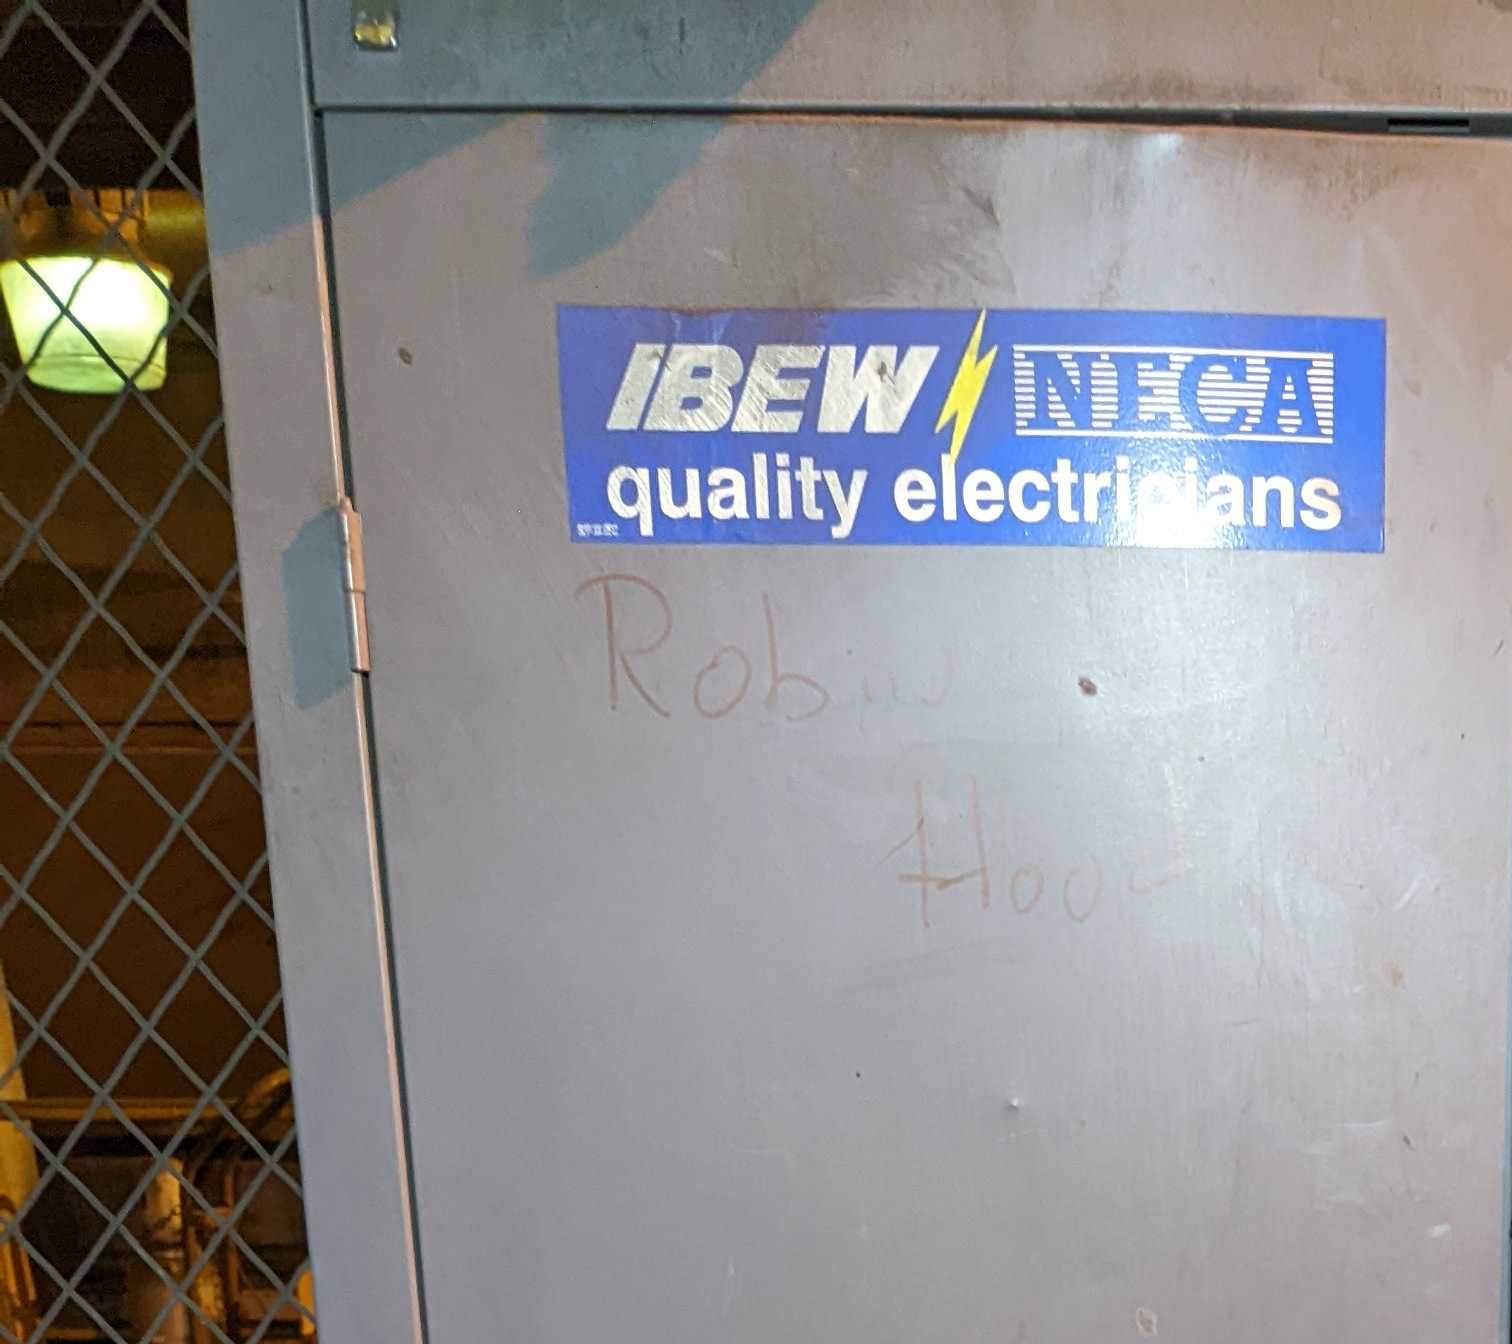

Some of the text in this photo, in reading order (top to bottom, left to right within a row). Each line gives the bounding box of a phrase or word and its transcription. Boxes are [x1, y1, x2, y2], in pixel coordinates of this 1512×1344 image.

[606, 344, 1335, 443] IBEW NECA
[606, 454, 1342, 537] quality electricians
[896, 773, 1185, 929] Hoo
